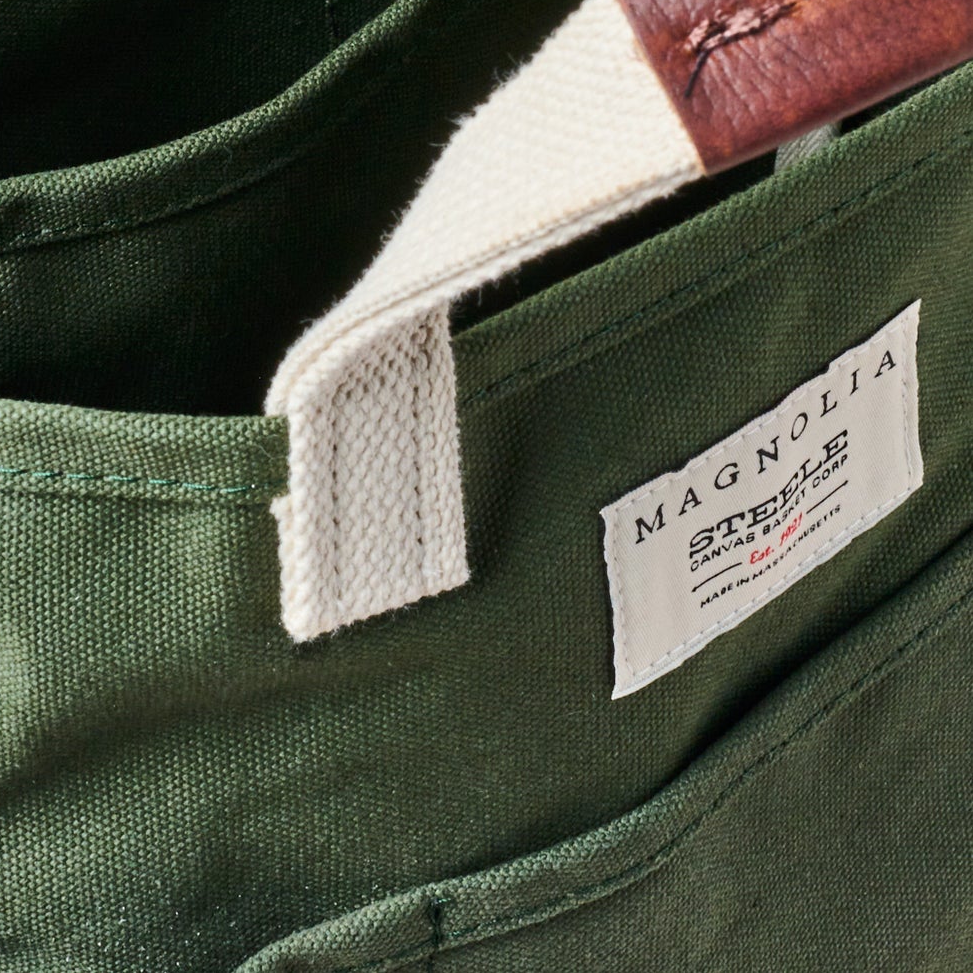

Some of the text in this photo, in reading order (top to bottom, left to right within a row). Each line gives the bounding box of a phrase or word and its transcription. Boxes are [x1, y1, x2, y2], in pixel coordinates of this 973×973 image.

[635, 350, 896, 544] MAGNOLIA
[689, 429, 849, 560] STEELE
[690, 454, 848, 572] CANVAS BASKET CORP
[700, 504, 841, 608] MADE IN MASSACHUSETTS
[750, 512, 803, 565] Est. 1921
